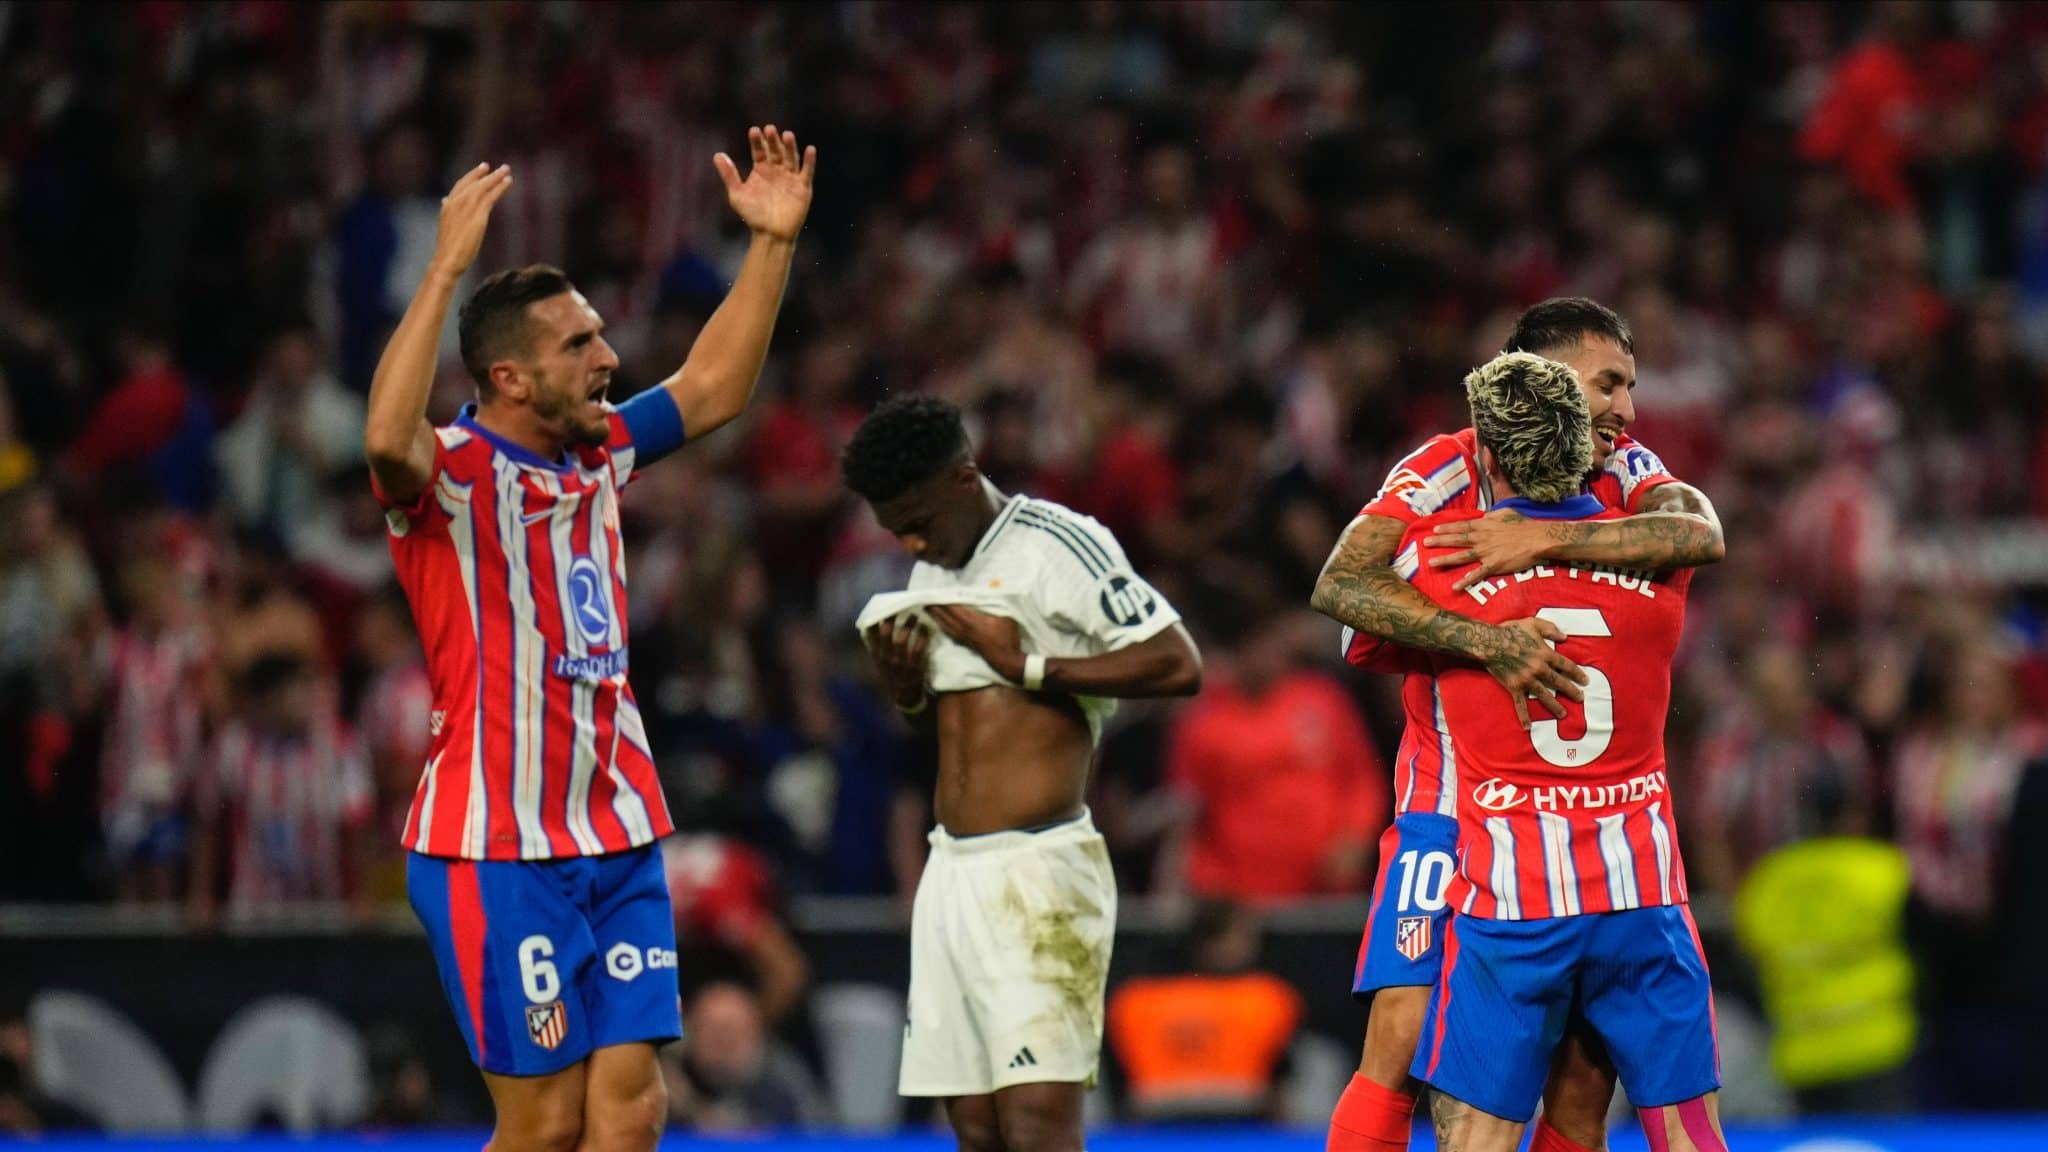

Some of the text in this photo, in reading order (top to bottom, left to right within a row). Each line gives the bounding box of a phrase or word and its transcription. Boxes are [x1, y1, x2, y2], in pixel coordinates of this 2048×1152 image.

[1101, 577, 1155, 626] hp
[1569, 560, 1656, 599] PAUL
[1528, 607, 1613, 767] 5
[1398, 850, 1454, 911] 10
[518, 934, 561, 1004] 6
